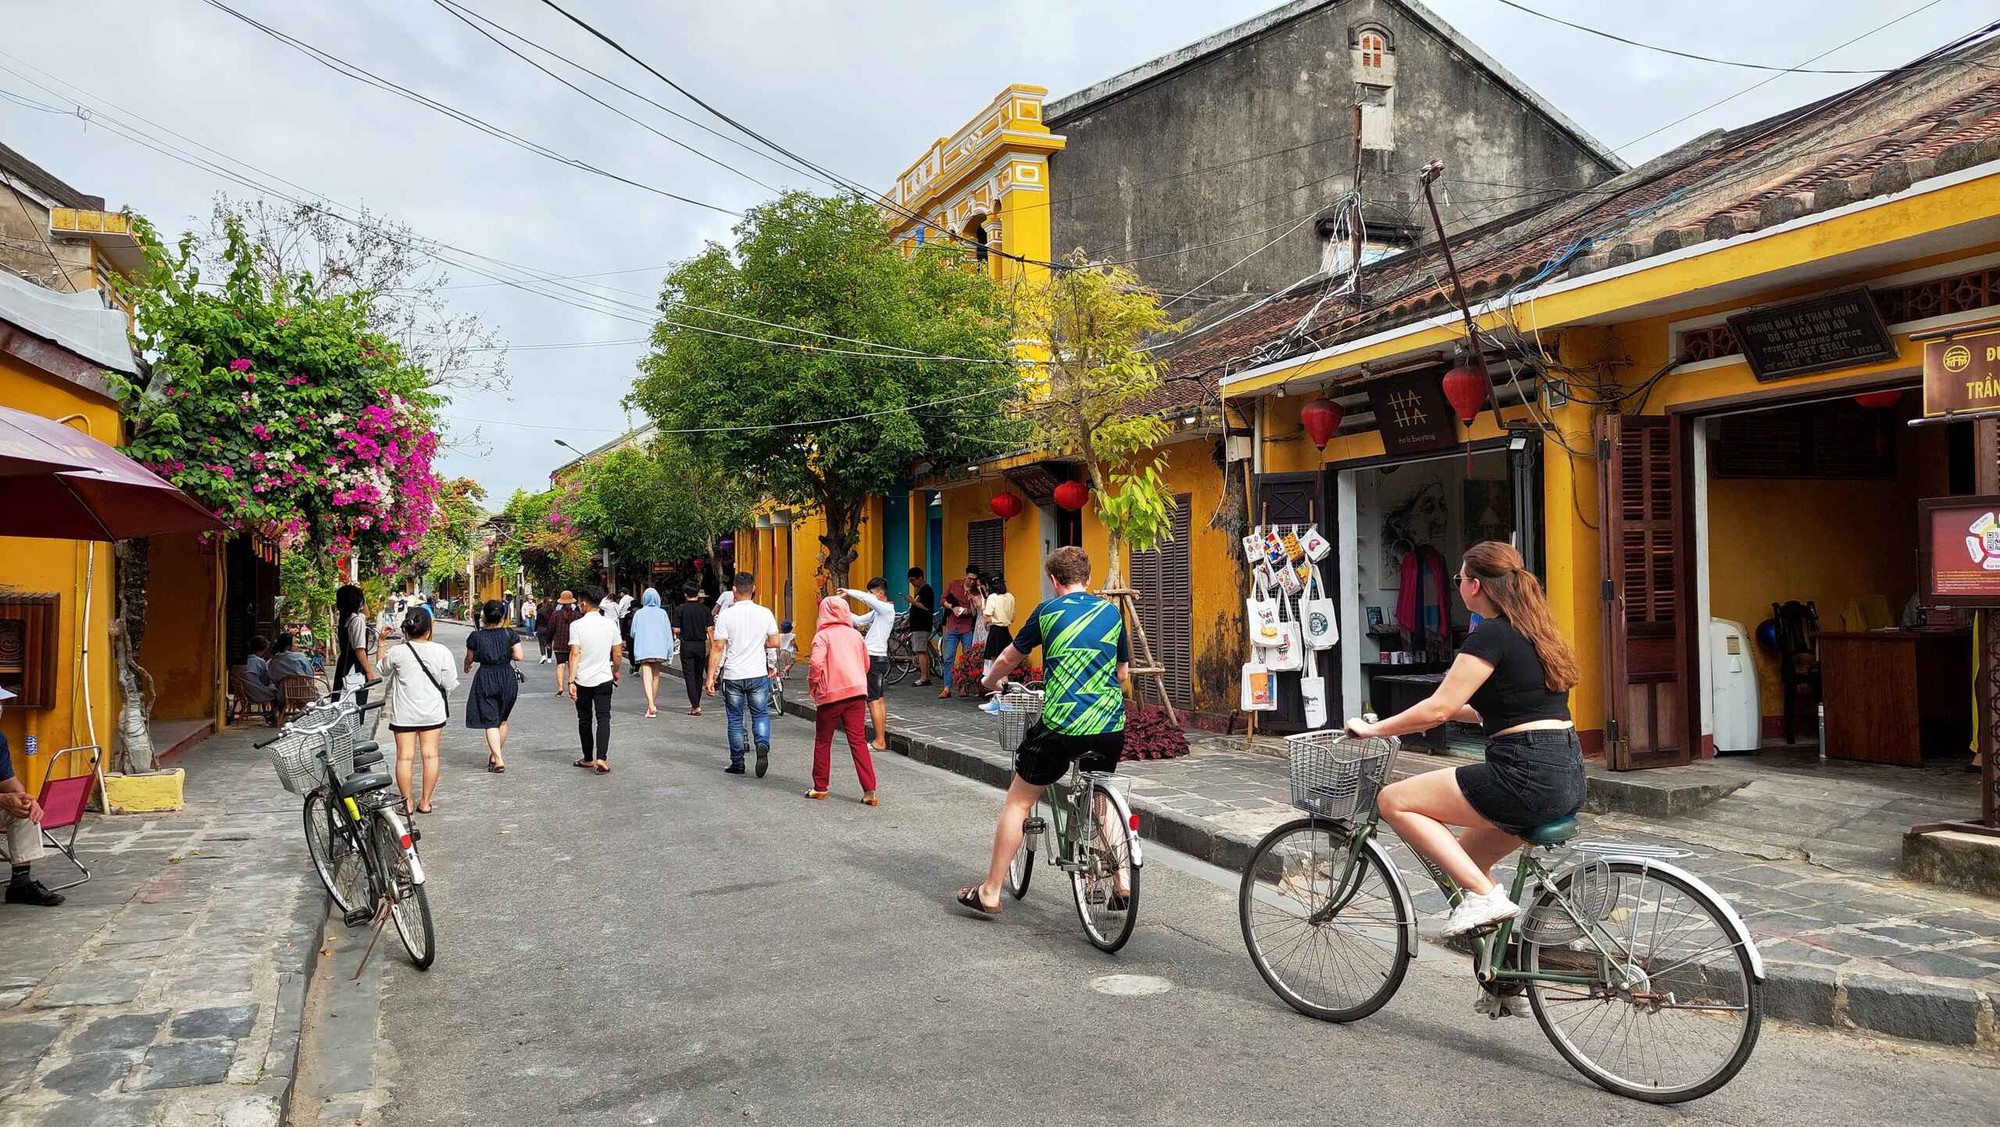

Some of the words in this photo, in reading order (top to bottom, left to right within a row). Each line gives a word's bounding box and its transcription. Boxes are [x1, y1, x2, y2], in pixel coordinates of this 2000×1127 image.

[1808, 309, 1832, 323] THAM
[1833, 304, 1860, 317] QUAN
[1833, 329, 1863, 340] OFFICE
[1782, 346, 1817, 360] TICKET
[1820, 340, 1850, 353] STALL
[1388, 388, 1422, 410] HA
[1394, 408, 1428, 428] HA
